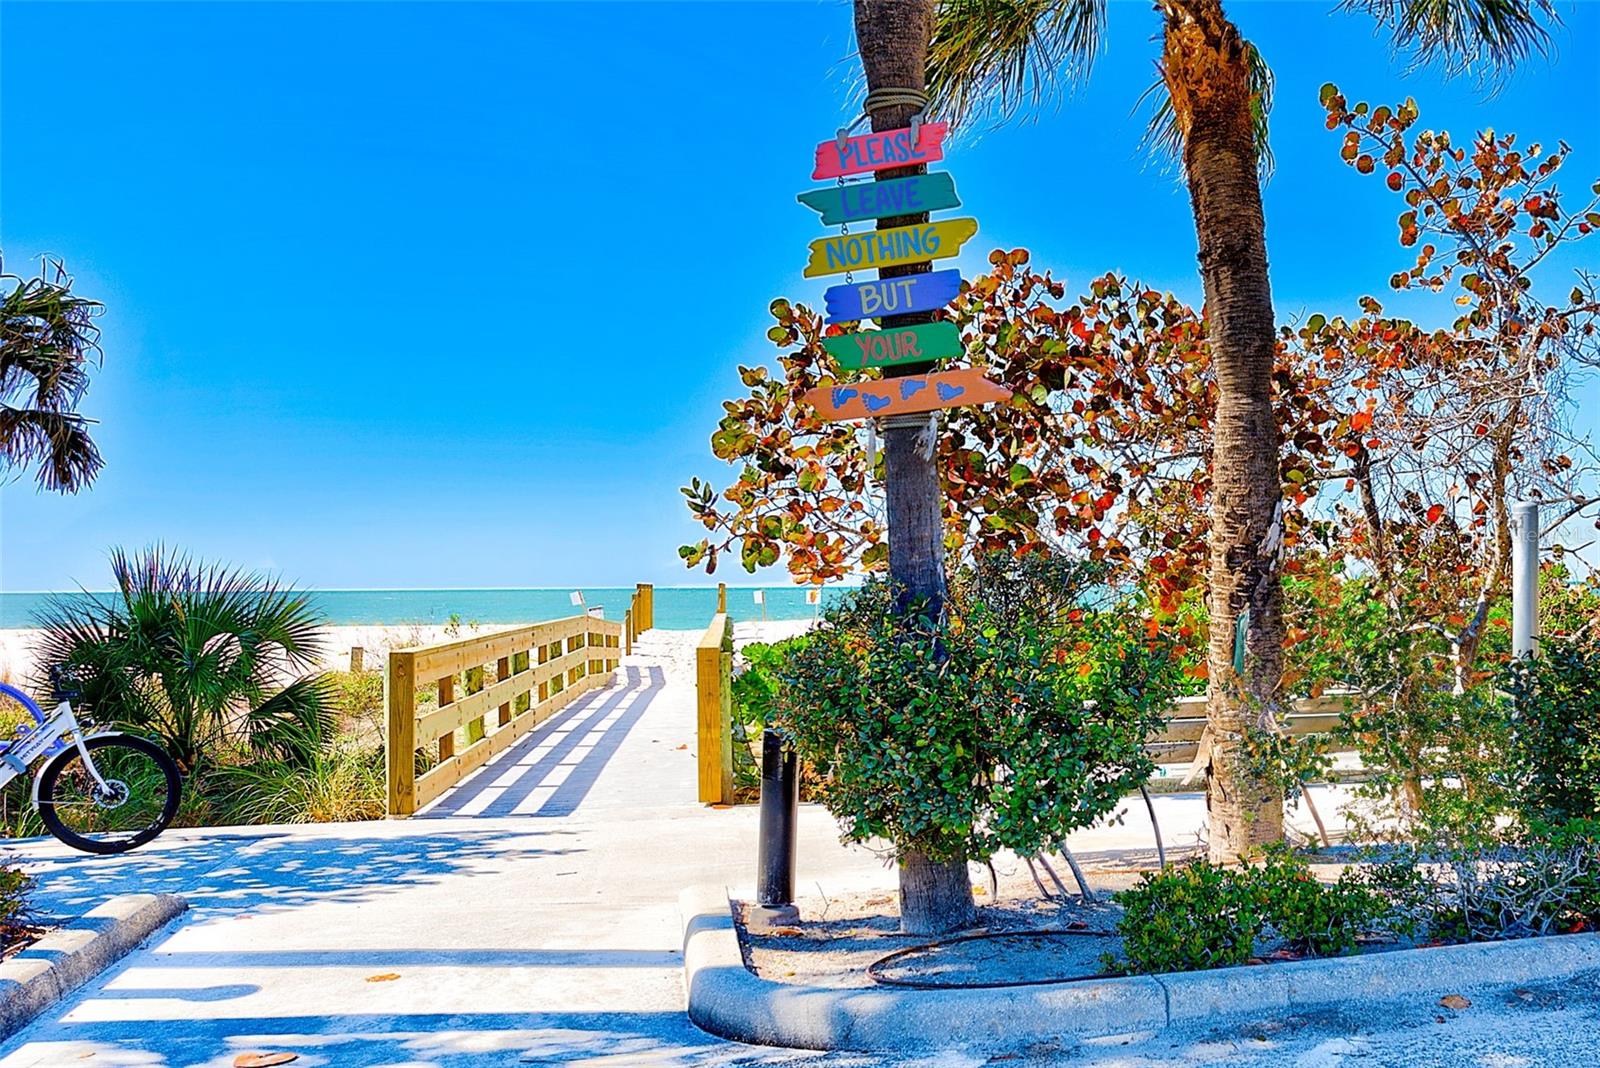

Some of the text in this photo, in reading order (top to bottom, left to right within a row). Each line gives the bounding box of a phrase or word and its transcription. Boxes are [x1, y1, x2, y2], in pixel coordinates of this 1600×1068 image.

[840, 178, 924, 218] LEAVE
[825, 227, 941, 269] NOTHING
[858, 280, 917, 315] BUT
[854, 331, 922, 366] YOUR
